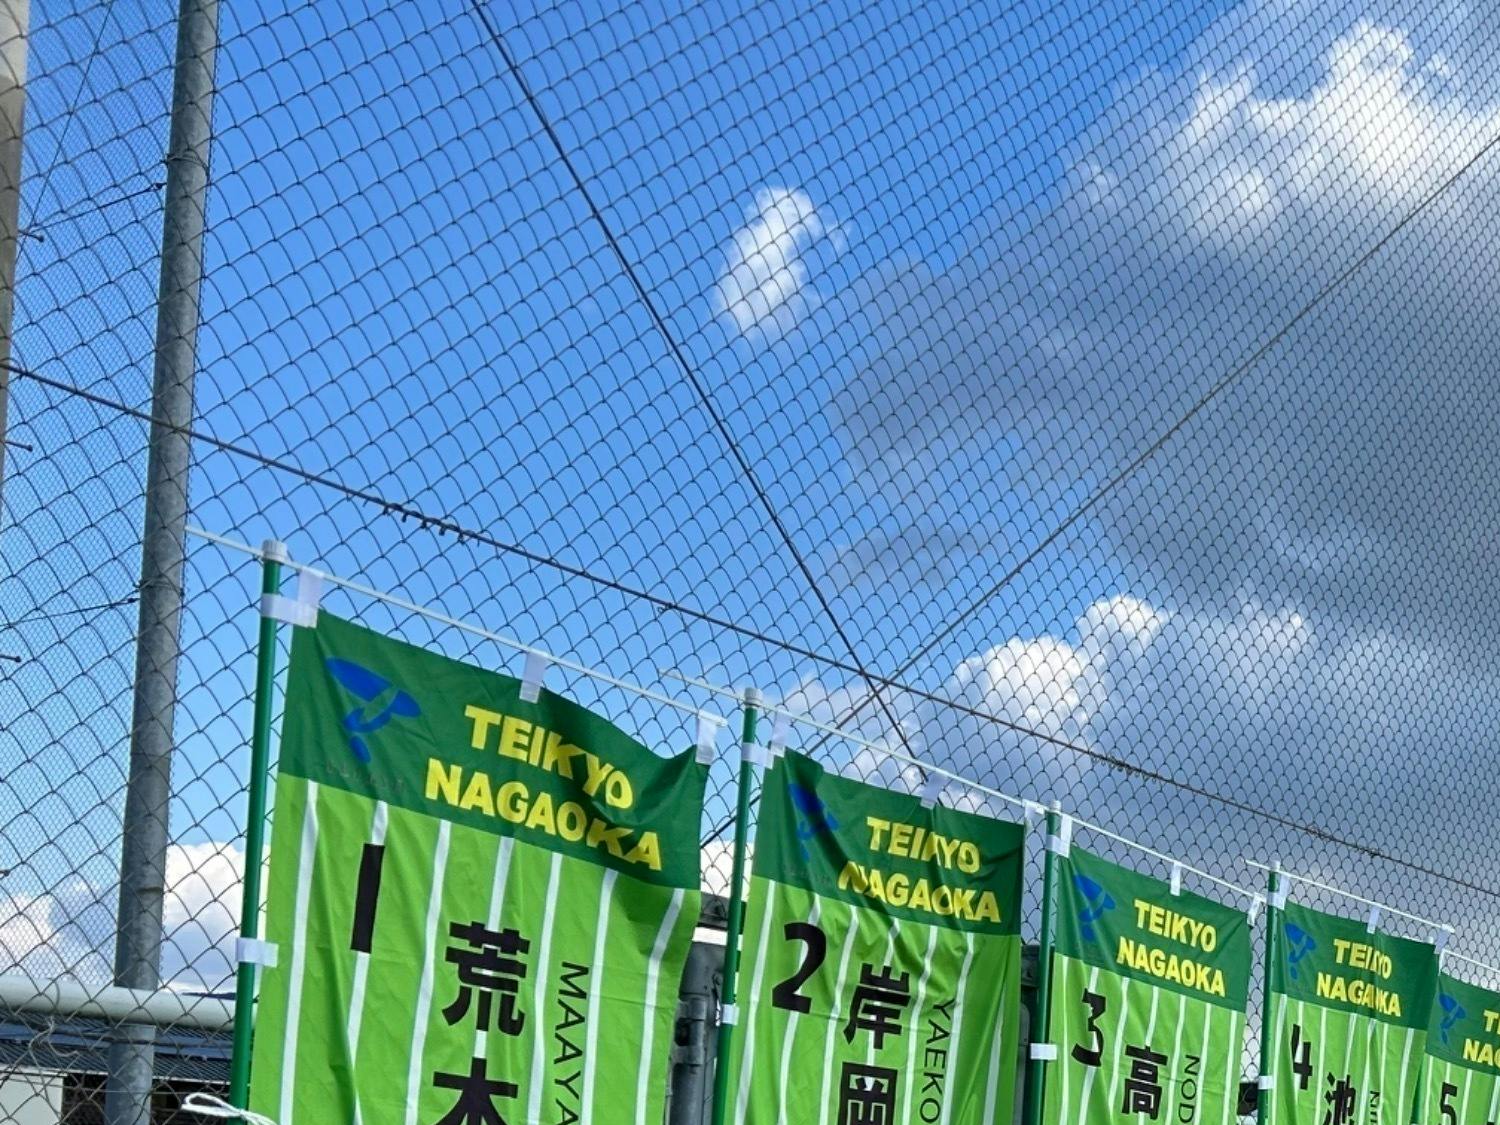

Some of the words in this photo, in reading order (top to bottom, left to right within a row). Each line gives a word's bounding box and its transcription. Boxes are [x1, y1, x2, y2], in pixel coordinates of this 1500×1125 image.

[464, 704, 635, 811] TEIKYO
[425, 758, 663, 872] NAGAOKA
[837, 861, 1002, 923] NAGAOKA
[1134, 899, 1216, 952] TEIKYO
[771, 922, 827, 1014] 2
[1116, 936, 1225, 997] NAGAOKA
[920, 1000, 957, 1124] YAEKO
[1071, 988, 1106, 1068] 3
[1292, 1024, 1313, 1091] 4
